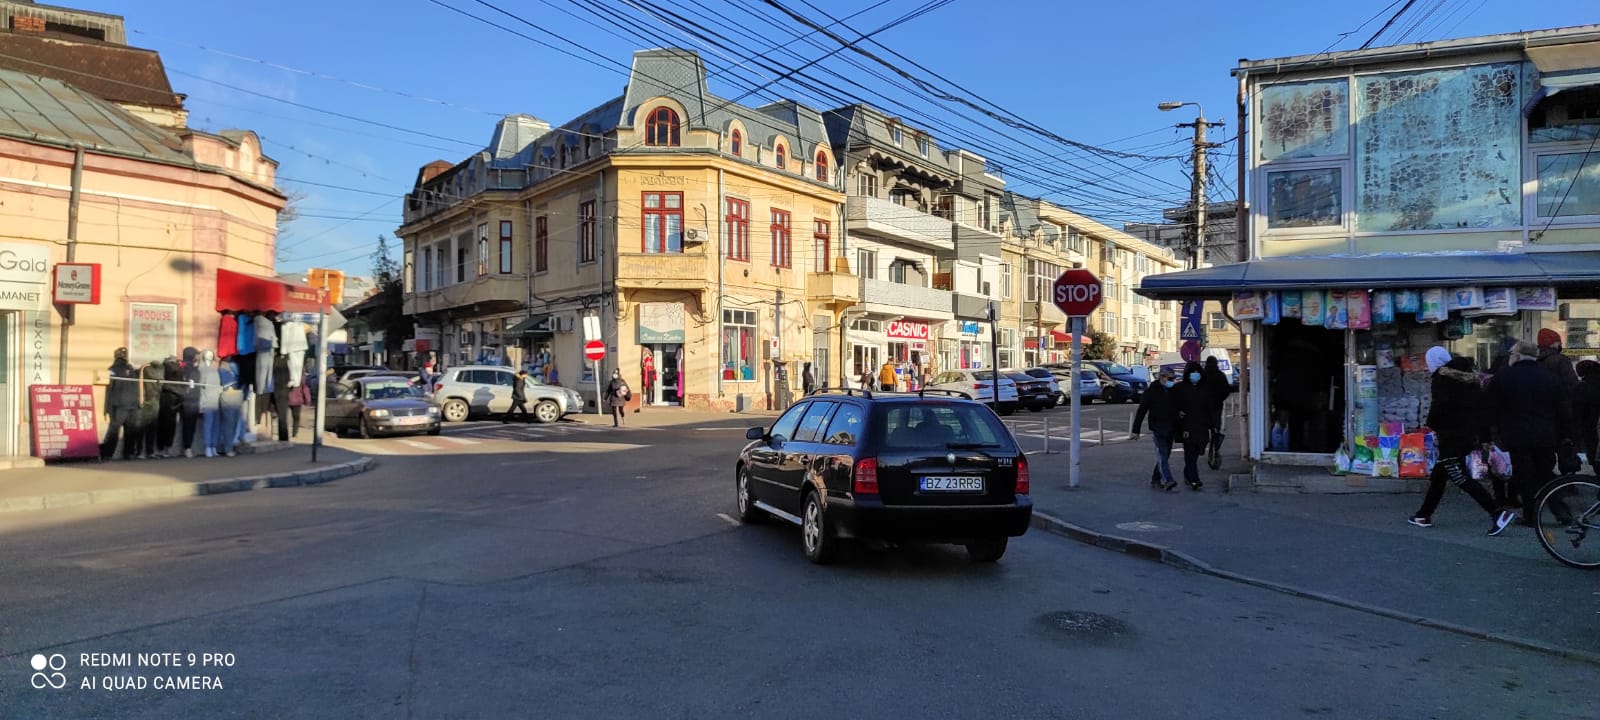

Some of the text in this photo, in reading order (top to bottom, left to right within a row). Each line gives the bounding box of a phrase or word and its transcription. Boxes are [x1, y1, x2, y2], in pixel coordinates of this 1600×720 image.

[0, 250, 47, 273] Gold
[0, 290, 40, 302] MANET
[1056, 283, 1100, 303] STOP
[133, 309, 174, 321] PRODUSE
[887, 321, 928, 337] CASNIC
[926, 478, 942, 489] BZ
